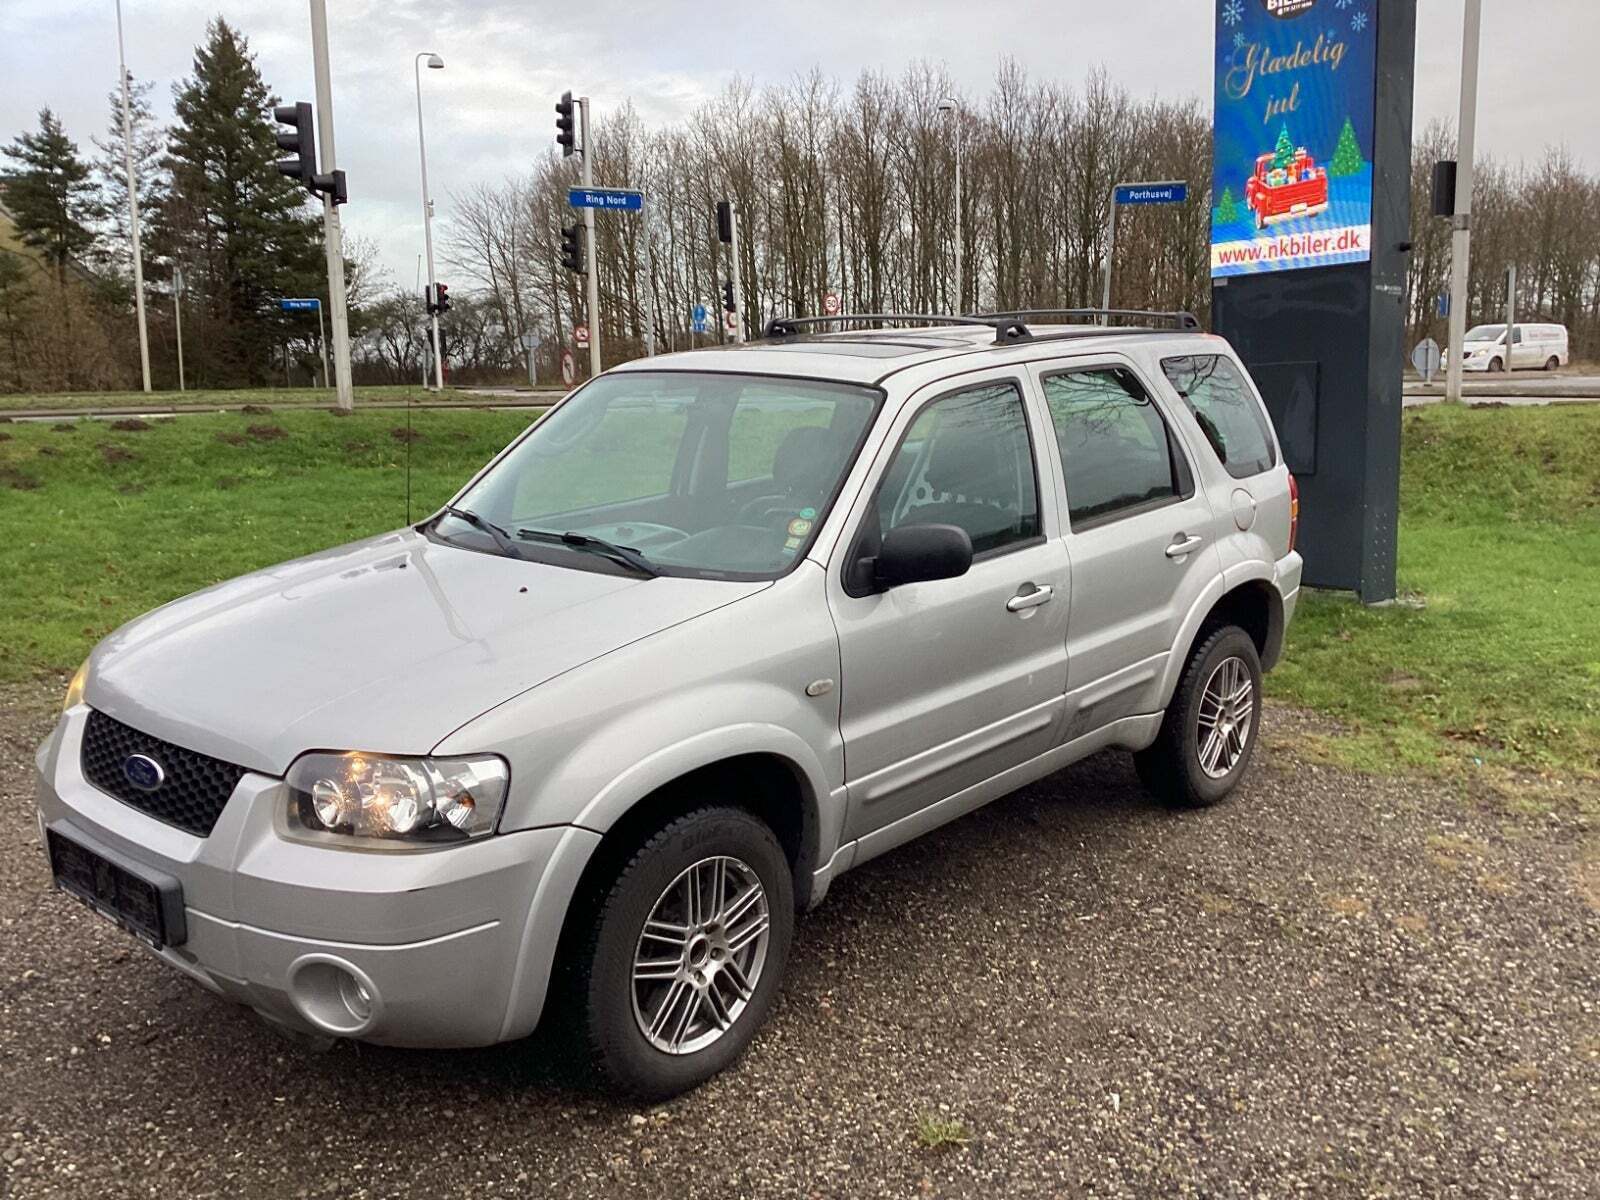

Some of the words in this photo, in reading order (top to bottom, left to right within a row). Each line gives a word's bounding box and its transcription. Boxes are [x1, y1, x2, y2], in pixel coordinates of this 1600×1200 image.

[1226, 33, 1346, 99] Glædelig
[1264, 81, 1299, 125] jul
[585, 194, 604, 205] Ring
[607, 195, 626, 205] Nord
[1129, 190, 1172, 200] Porthusvej
[1219, 230, 1360, 264] www.nkbiler.dk
